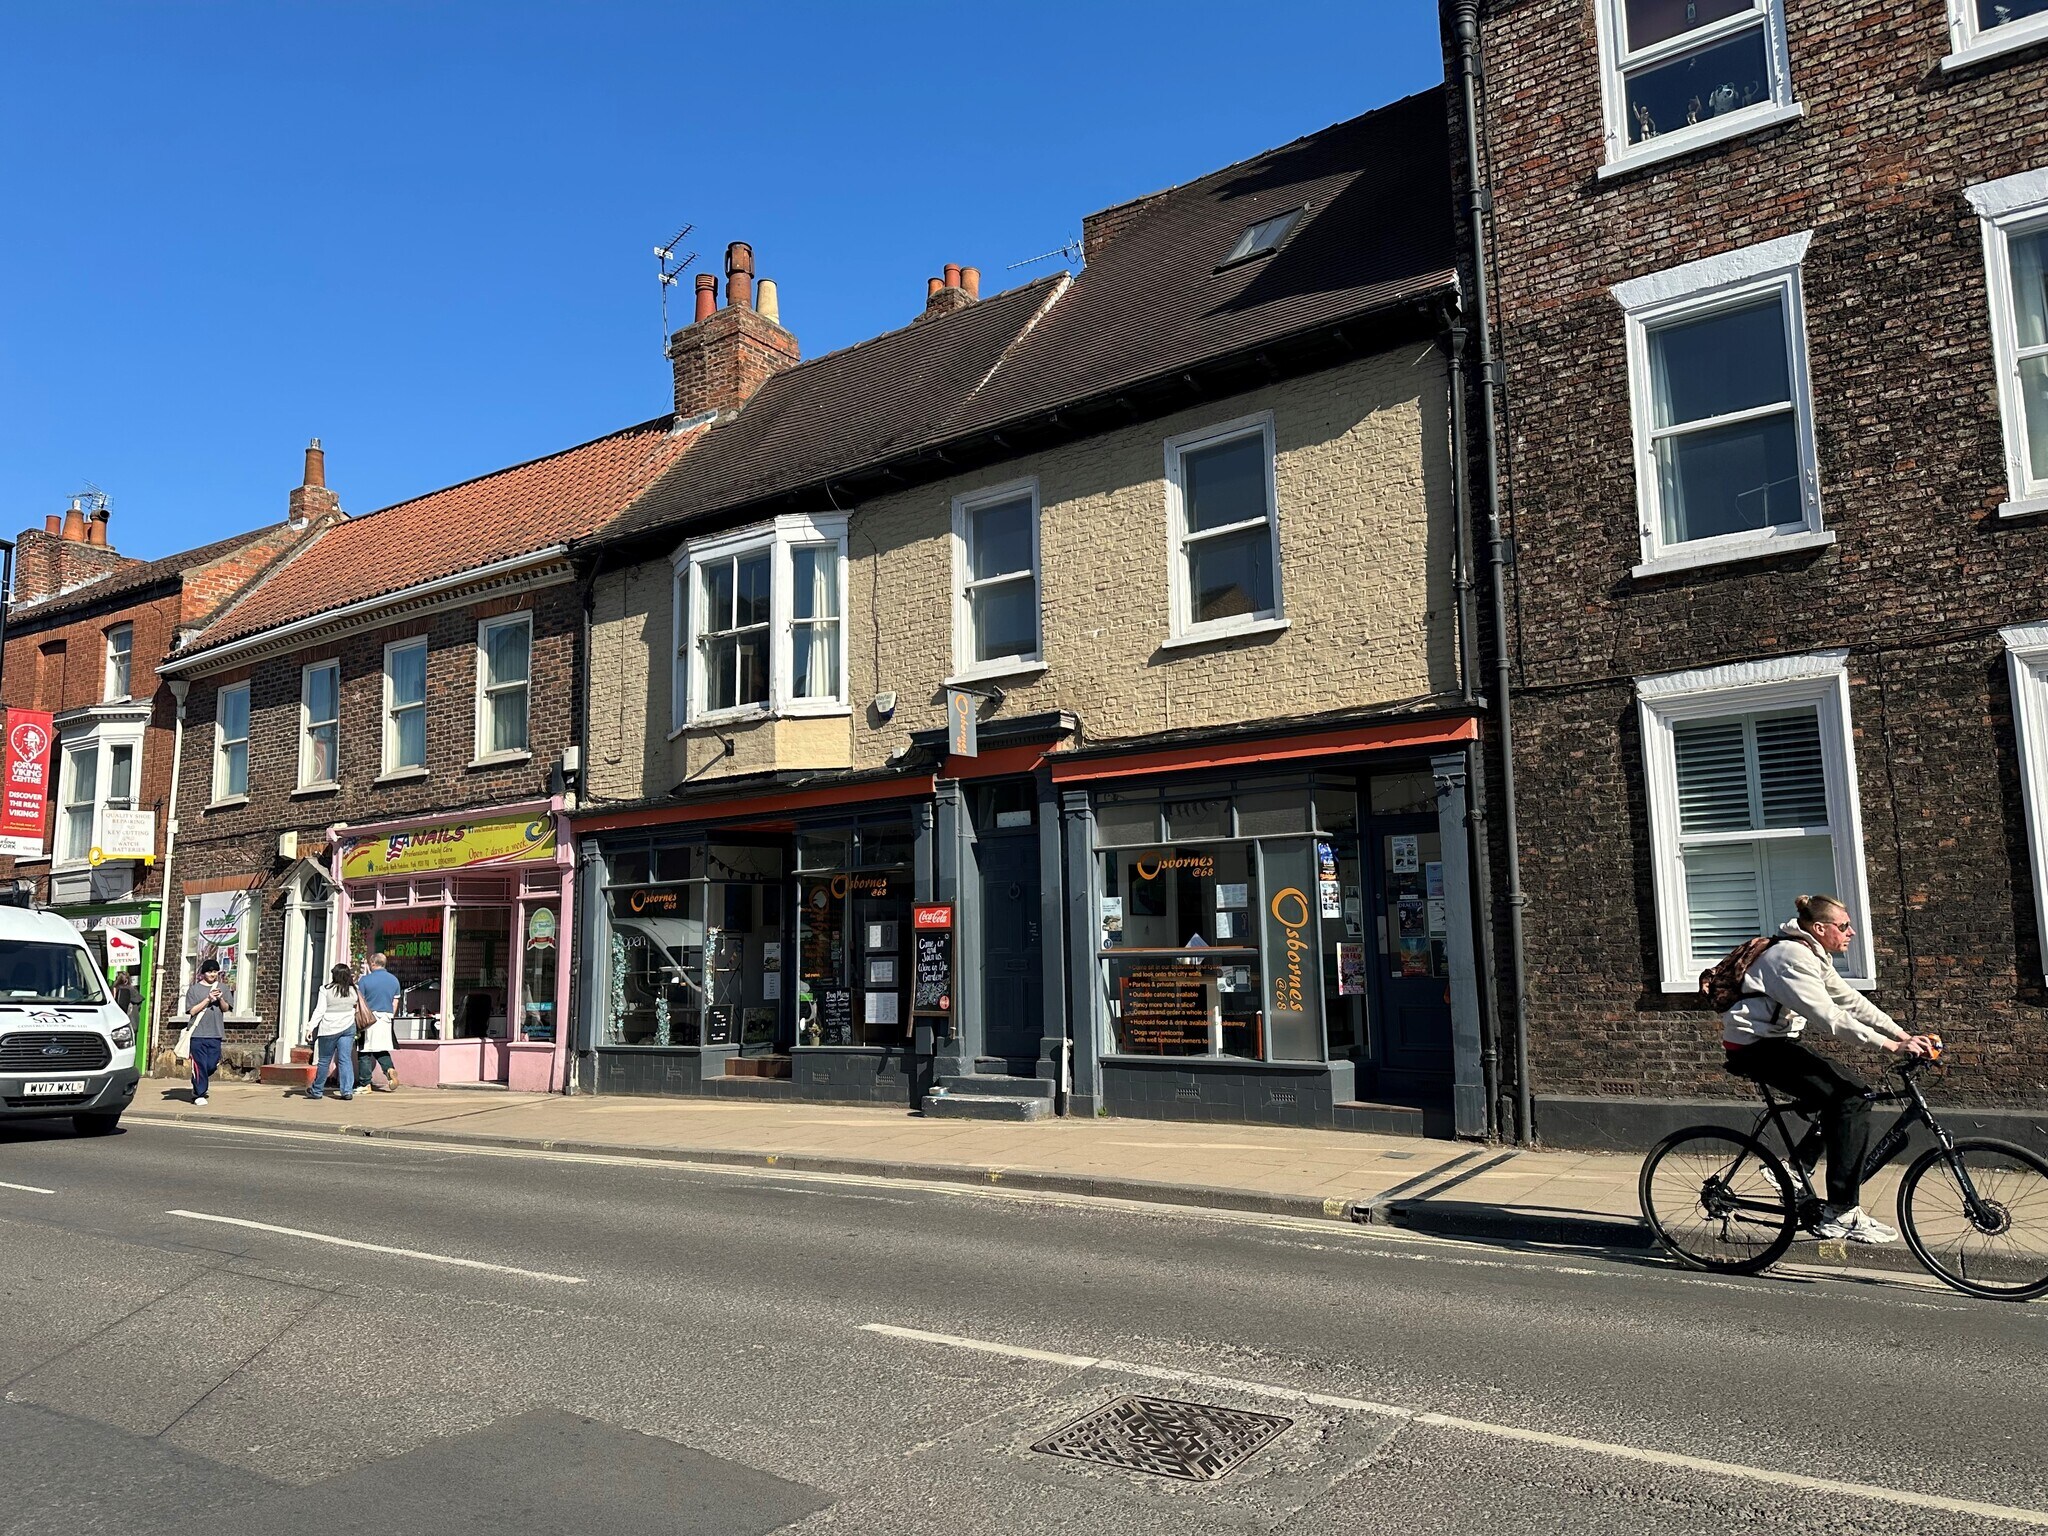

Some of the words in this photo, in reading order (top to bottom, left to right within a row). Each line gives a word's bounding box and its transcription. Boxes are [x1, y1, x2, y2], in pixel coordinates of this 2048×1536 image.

[954, 694, 969, 754] Osbornes
[12, 760, 43, 771] JORVIK
[11, 767, 42, 778] VIKING
[11, 775, 42, 785] CENTRE
[8, 791, 43, 801] DISCOVER
[9, 800, 22, 808] THE
[8, 808, 39, 818] VIKINGS
[385, 833, 411, 862] USA
[411, 825, 467, 847] NAILS
[468, 848, 482, 860] Open
[491, 844, 503, 856] days
[1137, 849, 1214, 880] Osbornes
[1192, 867, 1214, 877] @68
[830, 874, 887, 899] Osbornes
[870, 888, 887, 897] @68
[630, 889, 677, 913] Osbornes
[663, 902, 677, 910] @68
[1398, 901, 1423, 909] DRACULA
[82, 917, 103, 928] SHOE
[106, 915, 138, 926] REPAIRS
[918, 909, 949, 924] Coca-Cola
[623, 936, 646, 951] open
[937, 937, 944, 948] in
[926, 943, 937, 954] and
[1271, 887, 1309, 1012] Osbornes
[931, 962, 938, 972] in
[1177, 971, 1188, 979] city
[1156, 981, 1175, 989] private
[826, 991, 837, 1000] Dog
[837, 990, 850, 999] Menu
[1153, 991, 1175, 999] catering
[1276, 977, 1287, 1011] @68
[1133, 1001, 1148, 1009] Fancy
[30, 1083, 55, 1093] WV17
[57, 1082, 77, 1092] WXL
